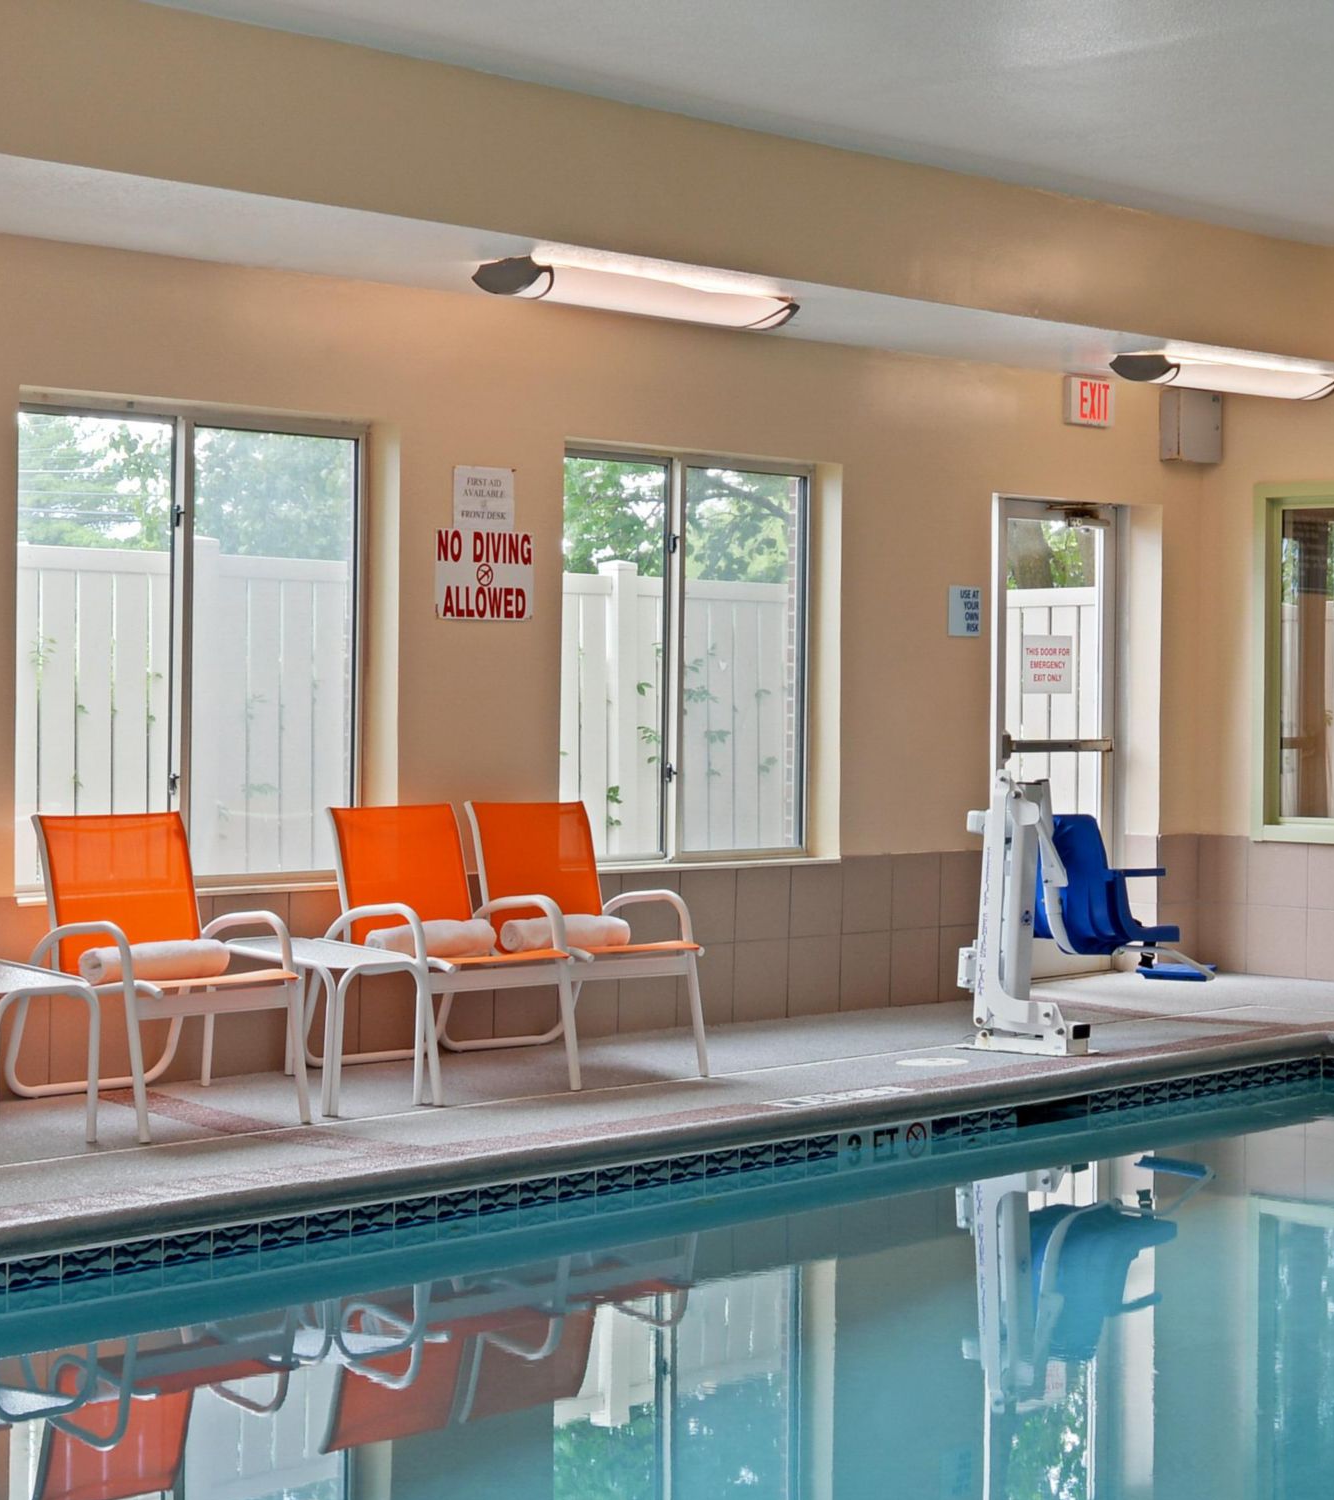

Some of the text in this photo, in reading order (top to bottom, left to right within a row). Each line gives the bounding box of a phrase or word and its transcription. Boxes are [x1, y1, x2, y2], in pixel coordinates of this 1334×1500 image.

[1079, 381, 1109, 421] EXIT
[467, 477, 502, 487] FIRST AID
[463, 488, 504, 498] AVAILABLE
[461, 510, 507, 520] FRONT DESK
[437, 529, 532, 565] NO DIVING
[960, 589, 979, 600] USE AT
[443, 585, 526, 619] ALLOWED
[963, 601, 979, 610] YOUR
[965, 612, 979, 621] OWN
[966, 622, 979, 632] RISK
[1026, 648, 1070, 656] THIS DOOR FOR
[1030, 660, 1065, 669] EMERGENCY
[1033, 674, 1061, 682] EXIT ONLY
